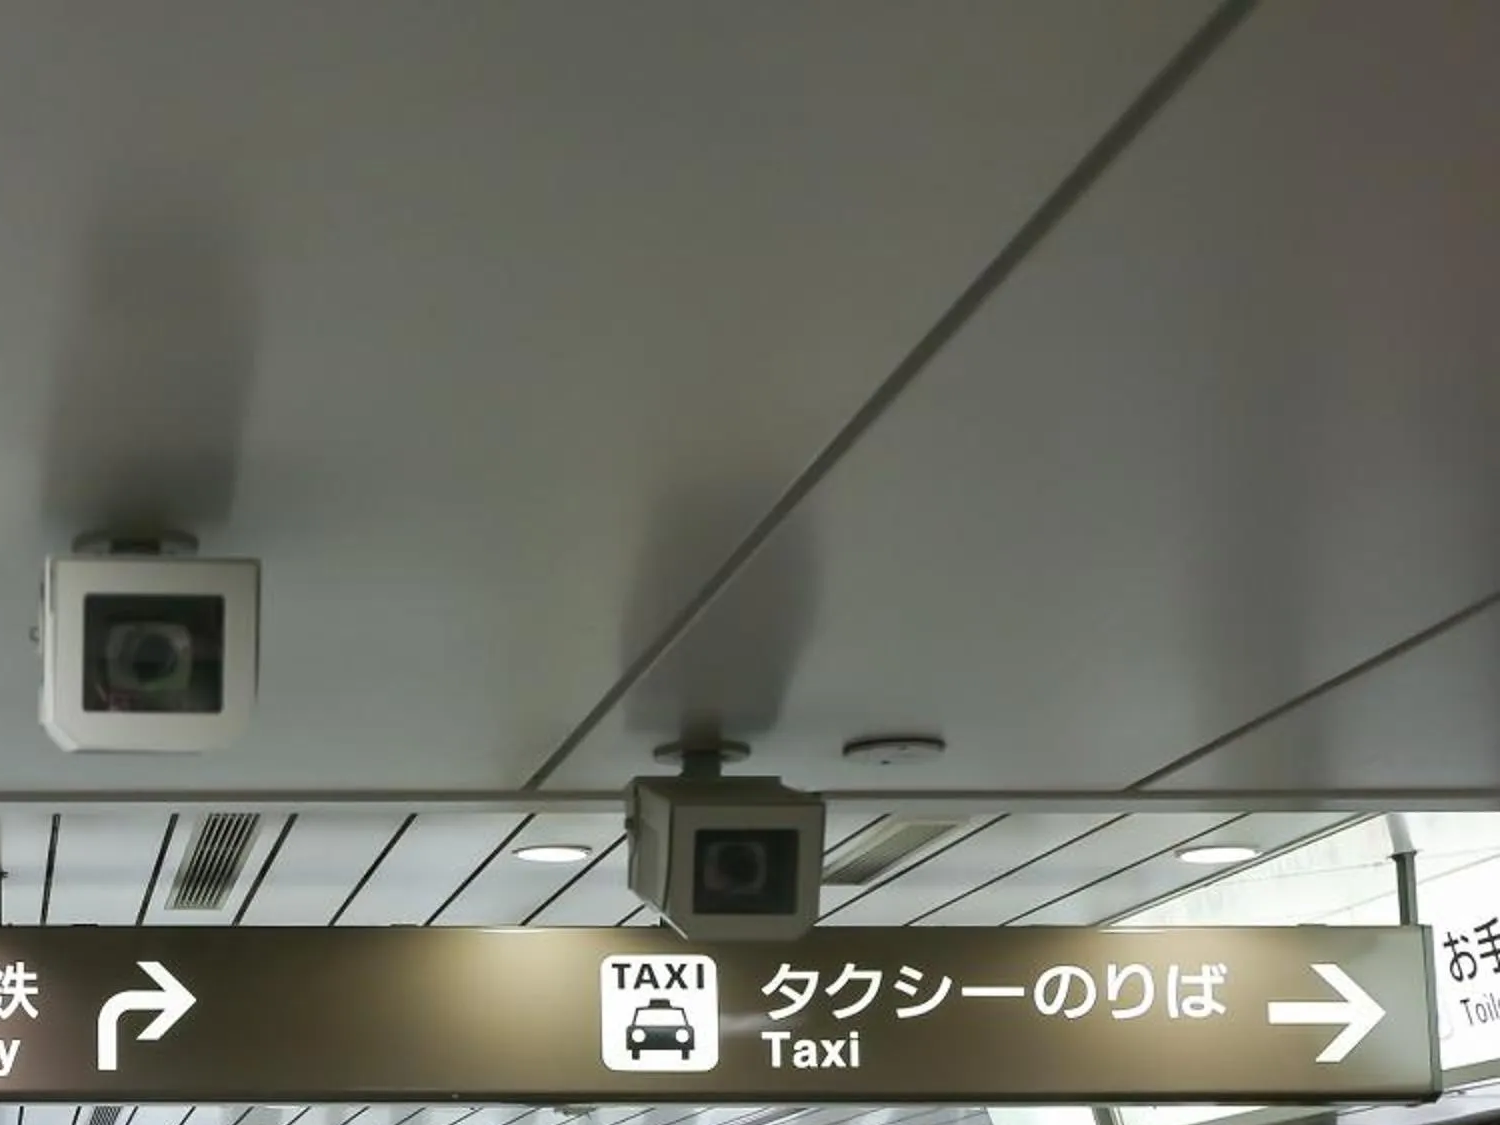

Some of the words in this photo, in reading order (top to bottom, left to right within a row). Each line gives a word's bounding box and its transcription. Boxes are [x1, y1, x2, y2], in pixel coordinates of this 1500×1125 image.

[611, 963, 705, 990] TAXI
[761, 962, 1228, 1020] タクシーのりば
[761, 1031, 859, 1068] Taxi
